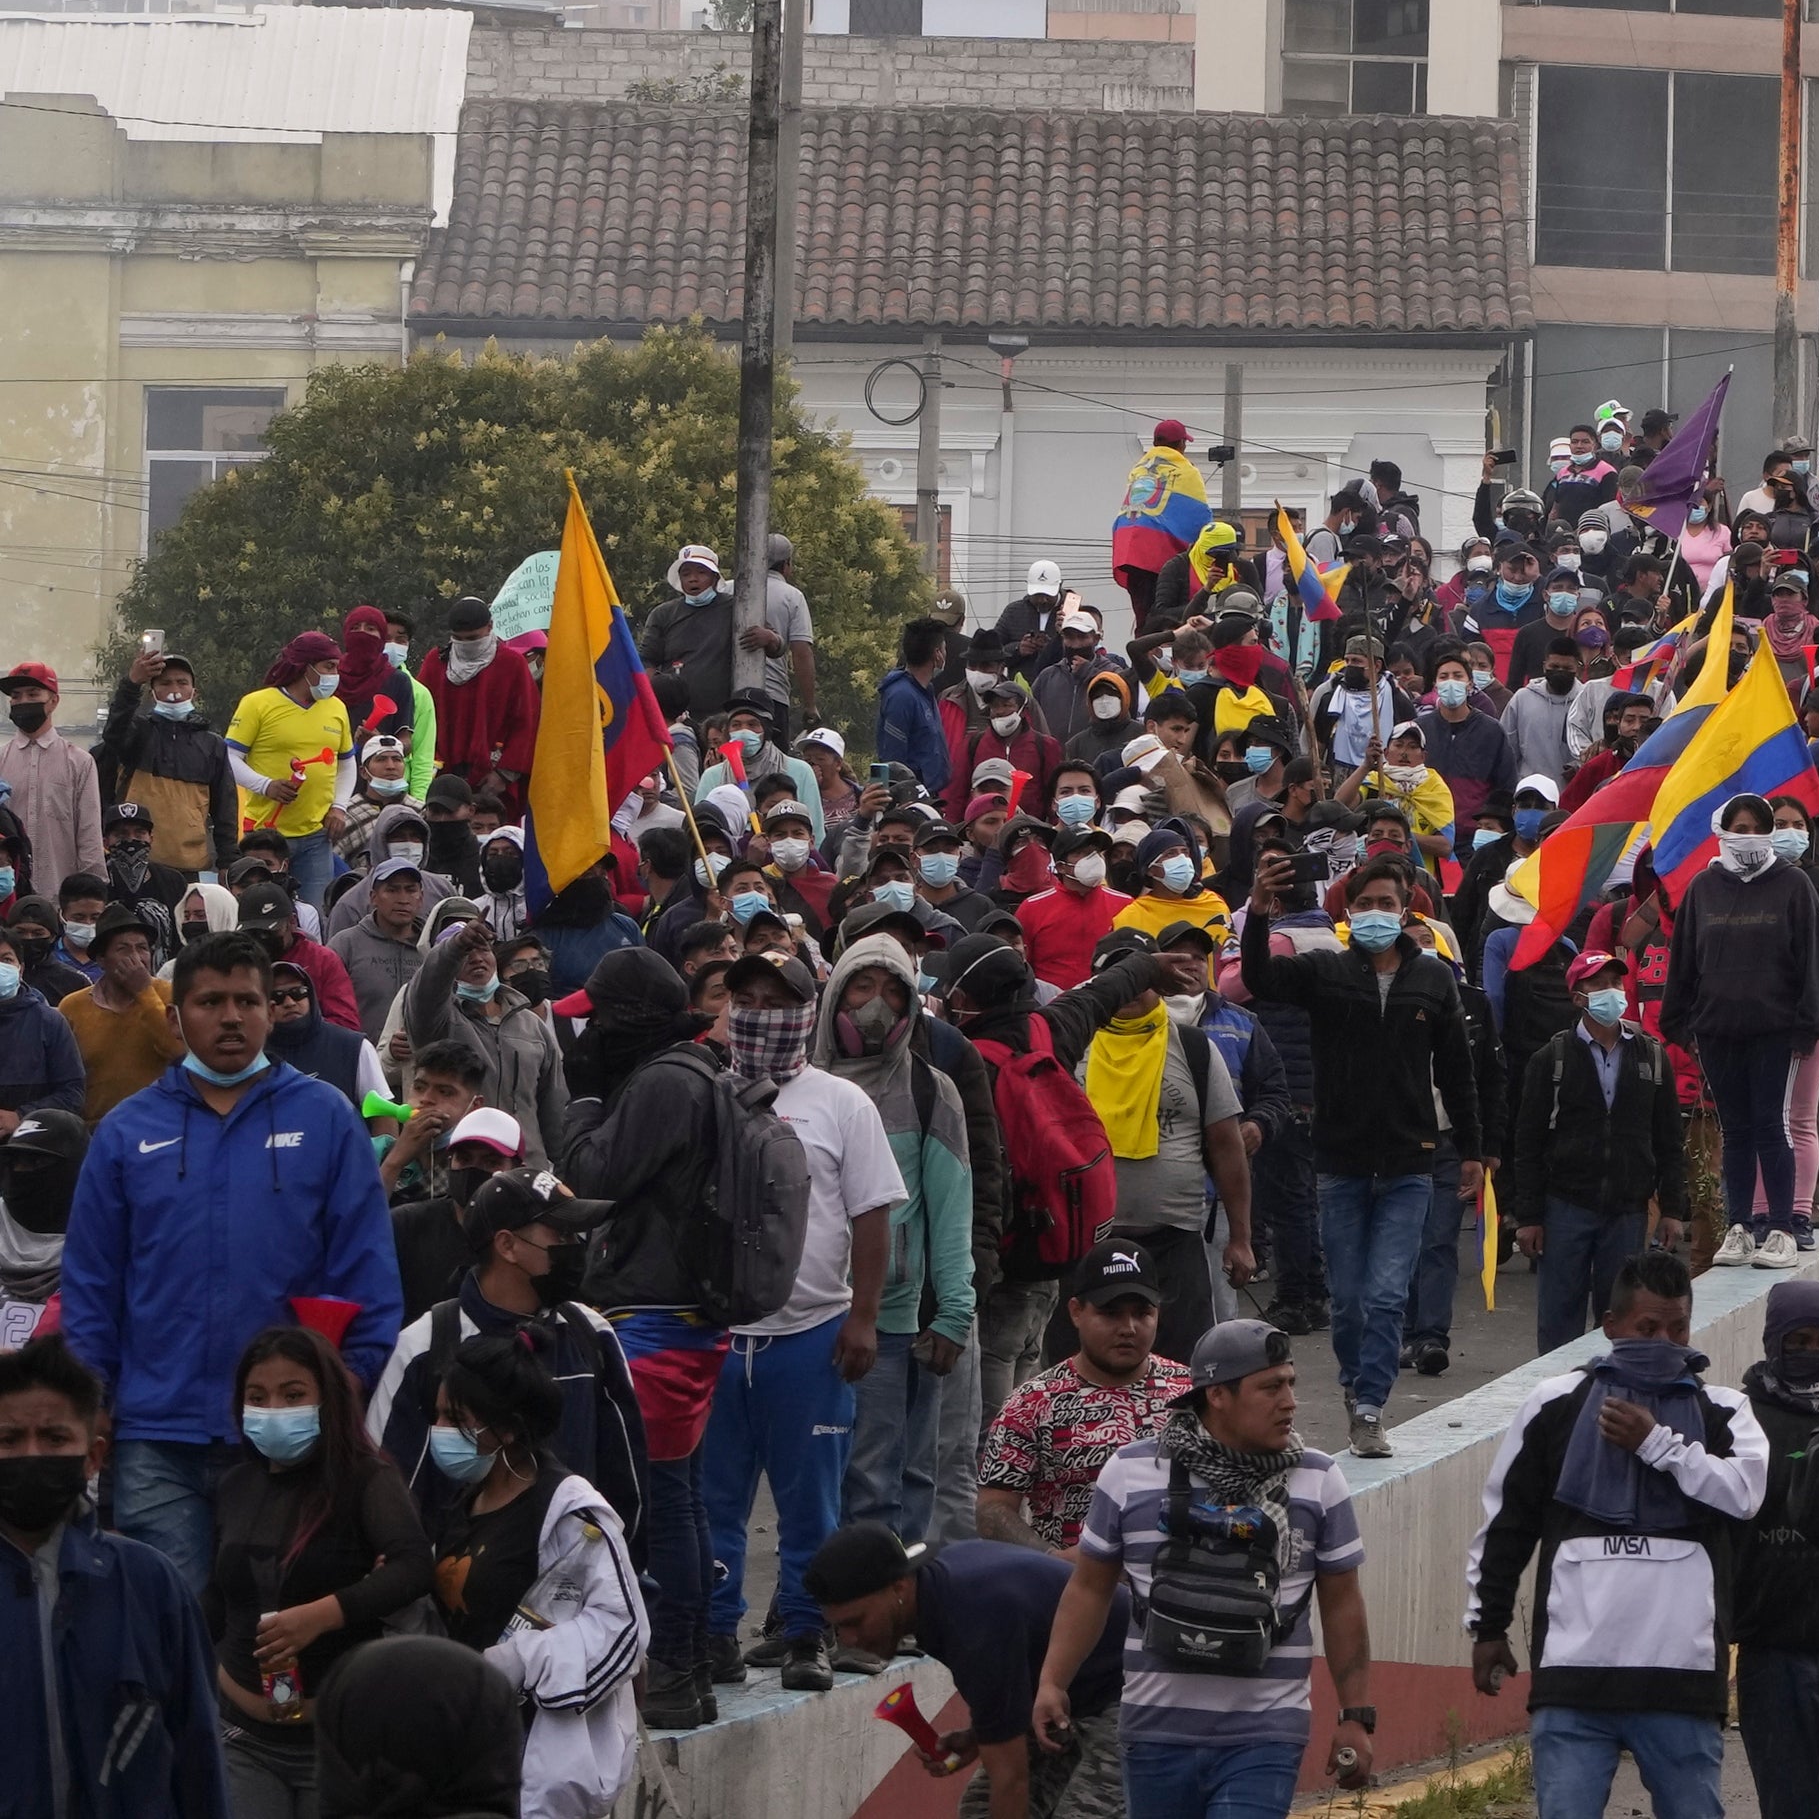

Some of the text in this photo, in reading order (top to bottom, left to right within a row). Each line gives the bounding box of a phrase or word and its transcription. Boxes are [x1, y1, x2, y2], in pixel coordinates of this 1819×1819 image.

[265, 1131, 305, 1150] NIKE
[1103, 1261, 1134, 1276] PUMA
[1603, 1535, 1651, 1557] NASA
[1177, 1645, 1222, 1659] adidas
